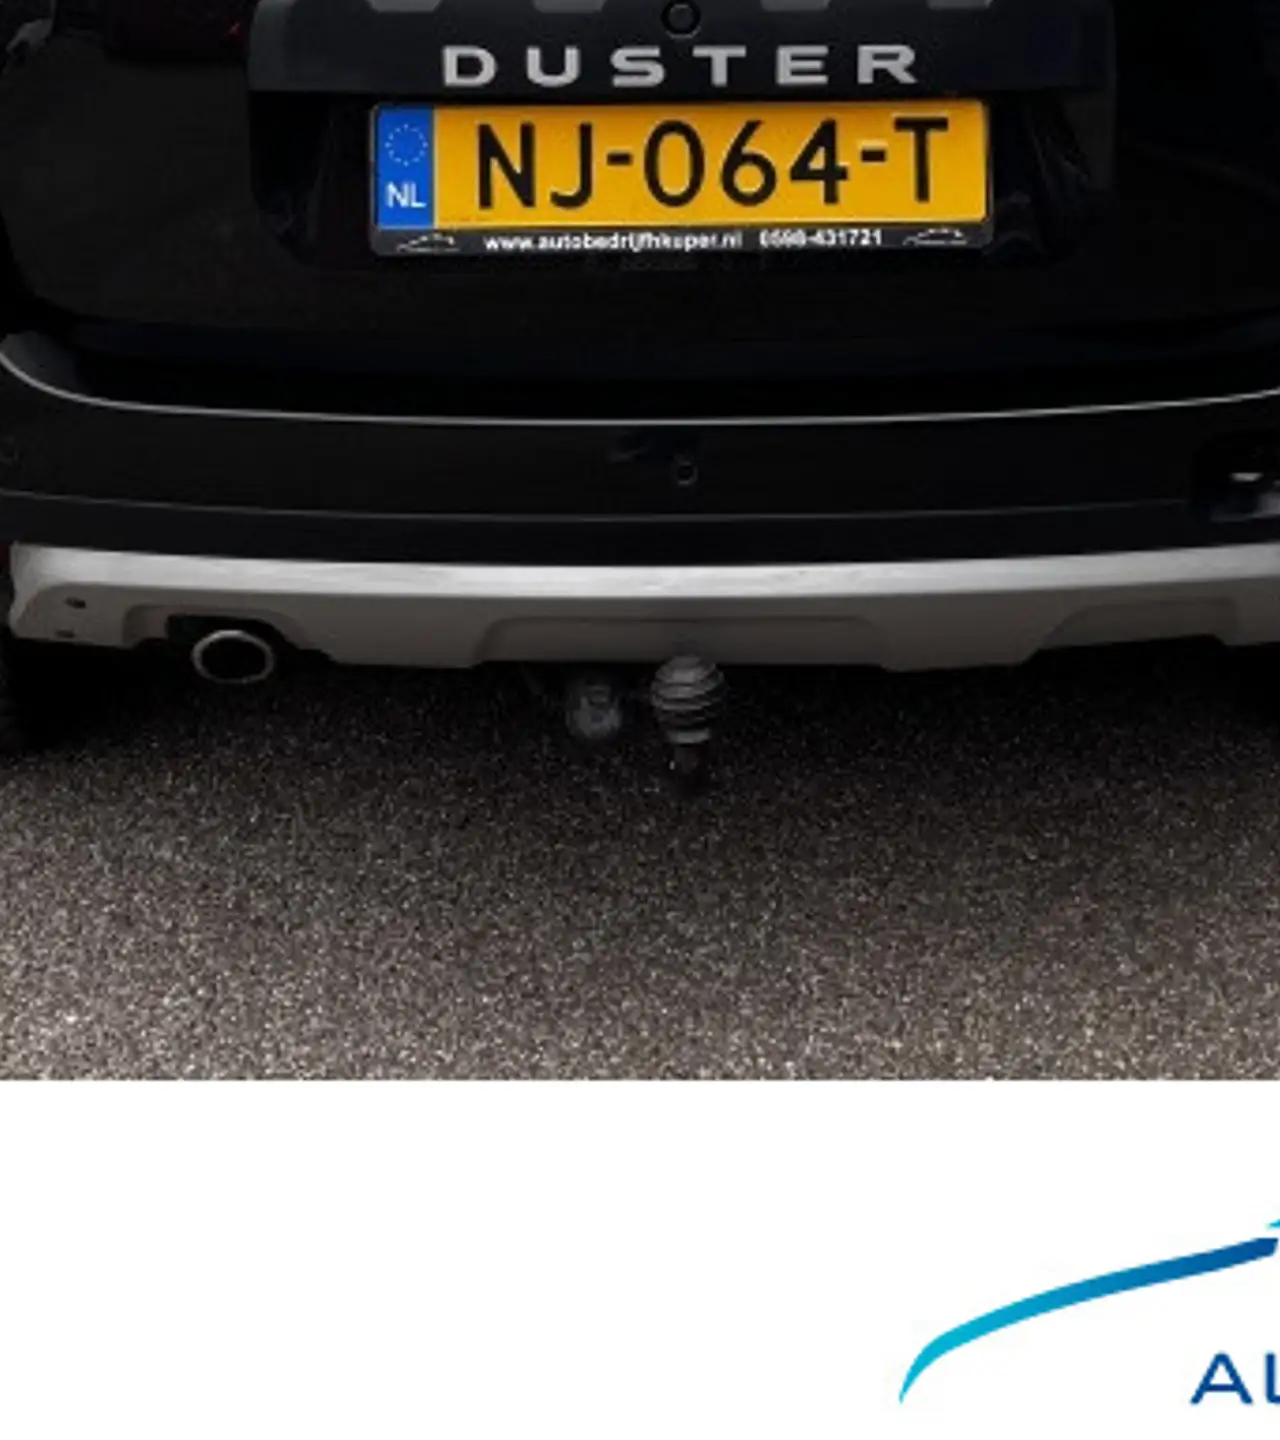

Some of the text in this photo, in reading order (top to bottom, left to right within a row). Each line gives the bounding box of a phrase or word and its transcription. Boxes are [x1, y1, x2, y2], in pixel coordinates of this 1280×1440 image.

[442, 45, 916, 87] DUSTER
[477, 117, 950, 210] NJ-064-T
[386, 183, 426, 208] NL
